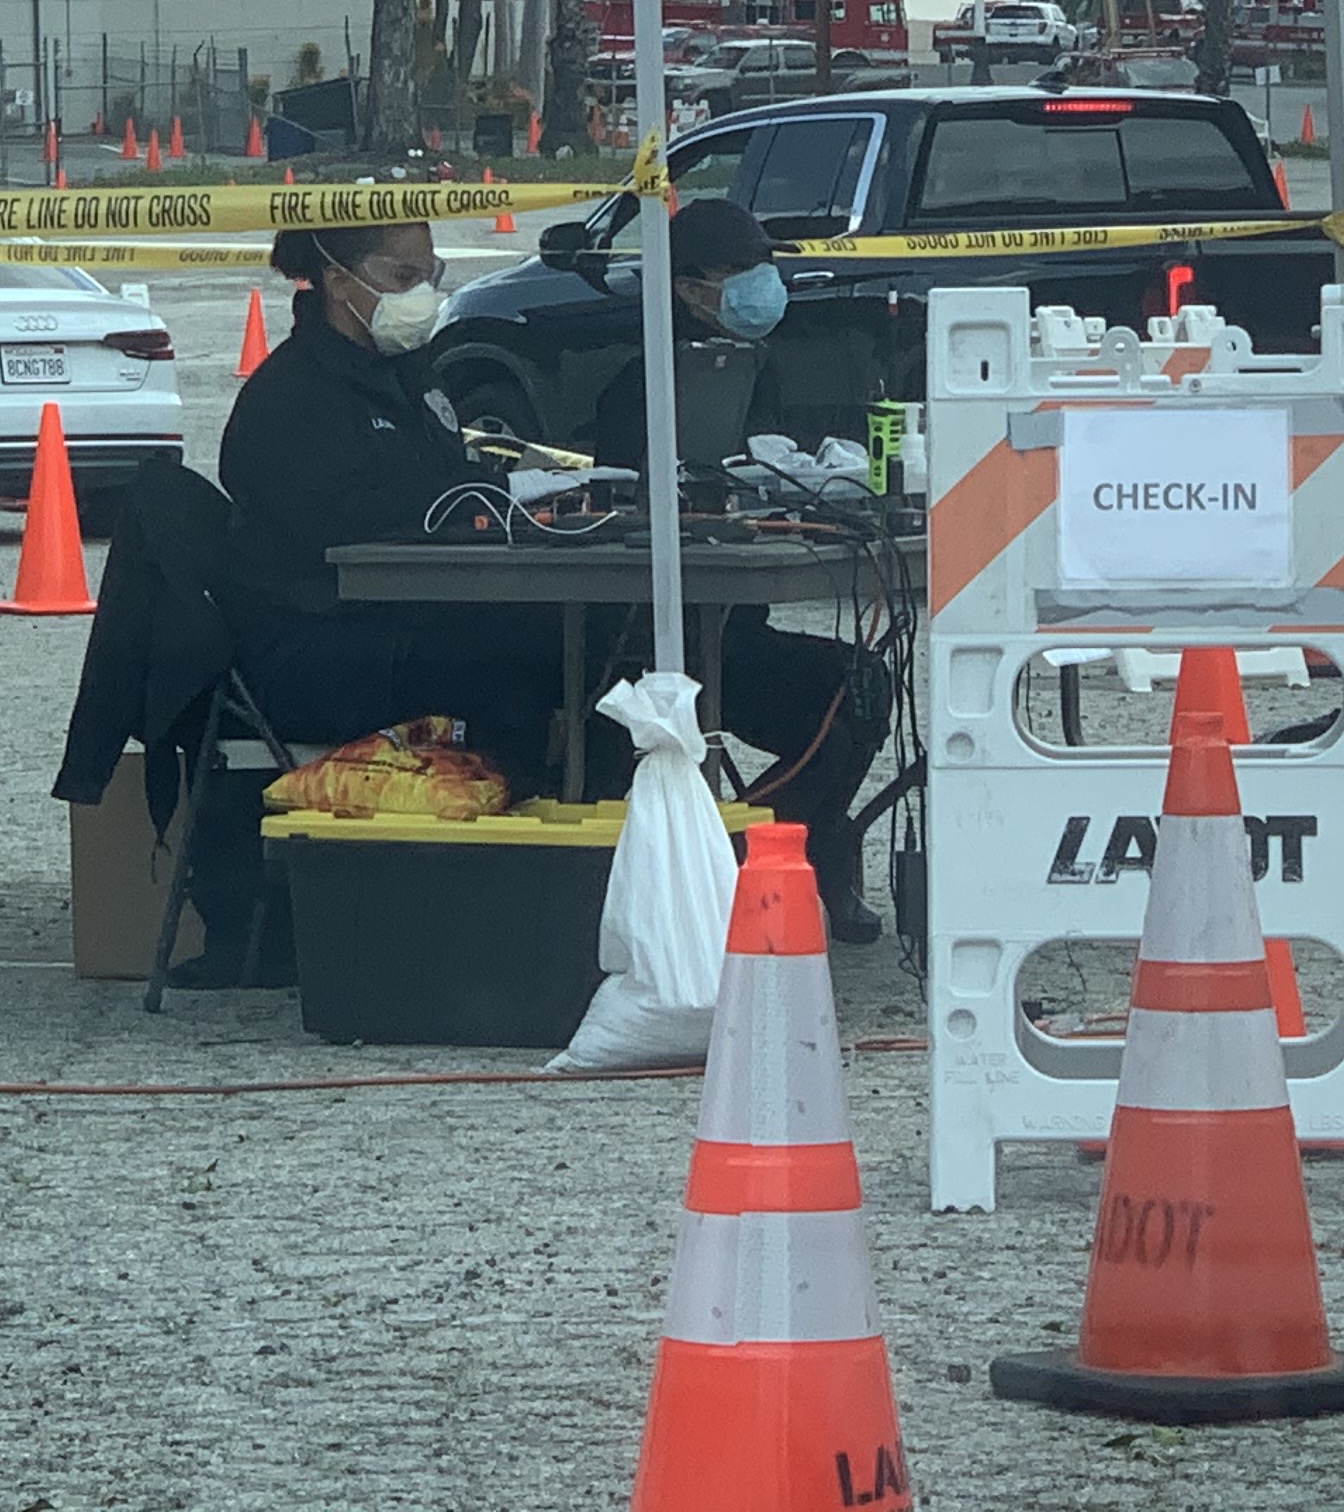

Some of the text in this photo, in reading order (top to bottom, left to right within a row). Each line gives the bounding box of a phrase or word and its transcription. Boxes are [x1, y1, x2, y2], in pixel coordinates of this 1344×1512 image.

[26, 196, 68, 229] LINE
[74, 196, 98, 228] DO
[105, 195, 143, 228] NOT
[148, 193, 212, 226] CROSS
[270, 194, 314, 224] FIRE
[320, 192, 366, 222] LINE
[370, 191, 397, 220] DO
[402, 190, 443, 218] NOT
[1093, 483, 1257, 511] CHECK-IN
[1047, 815, 1317, 885] LAT
